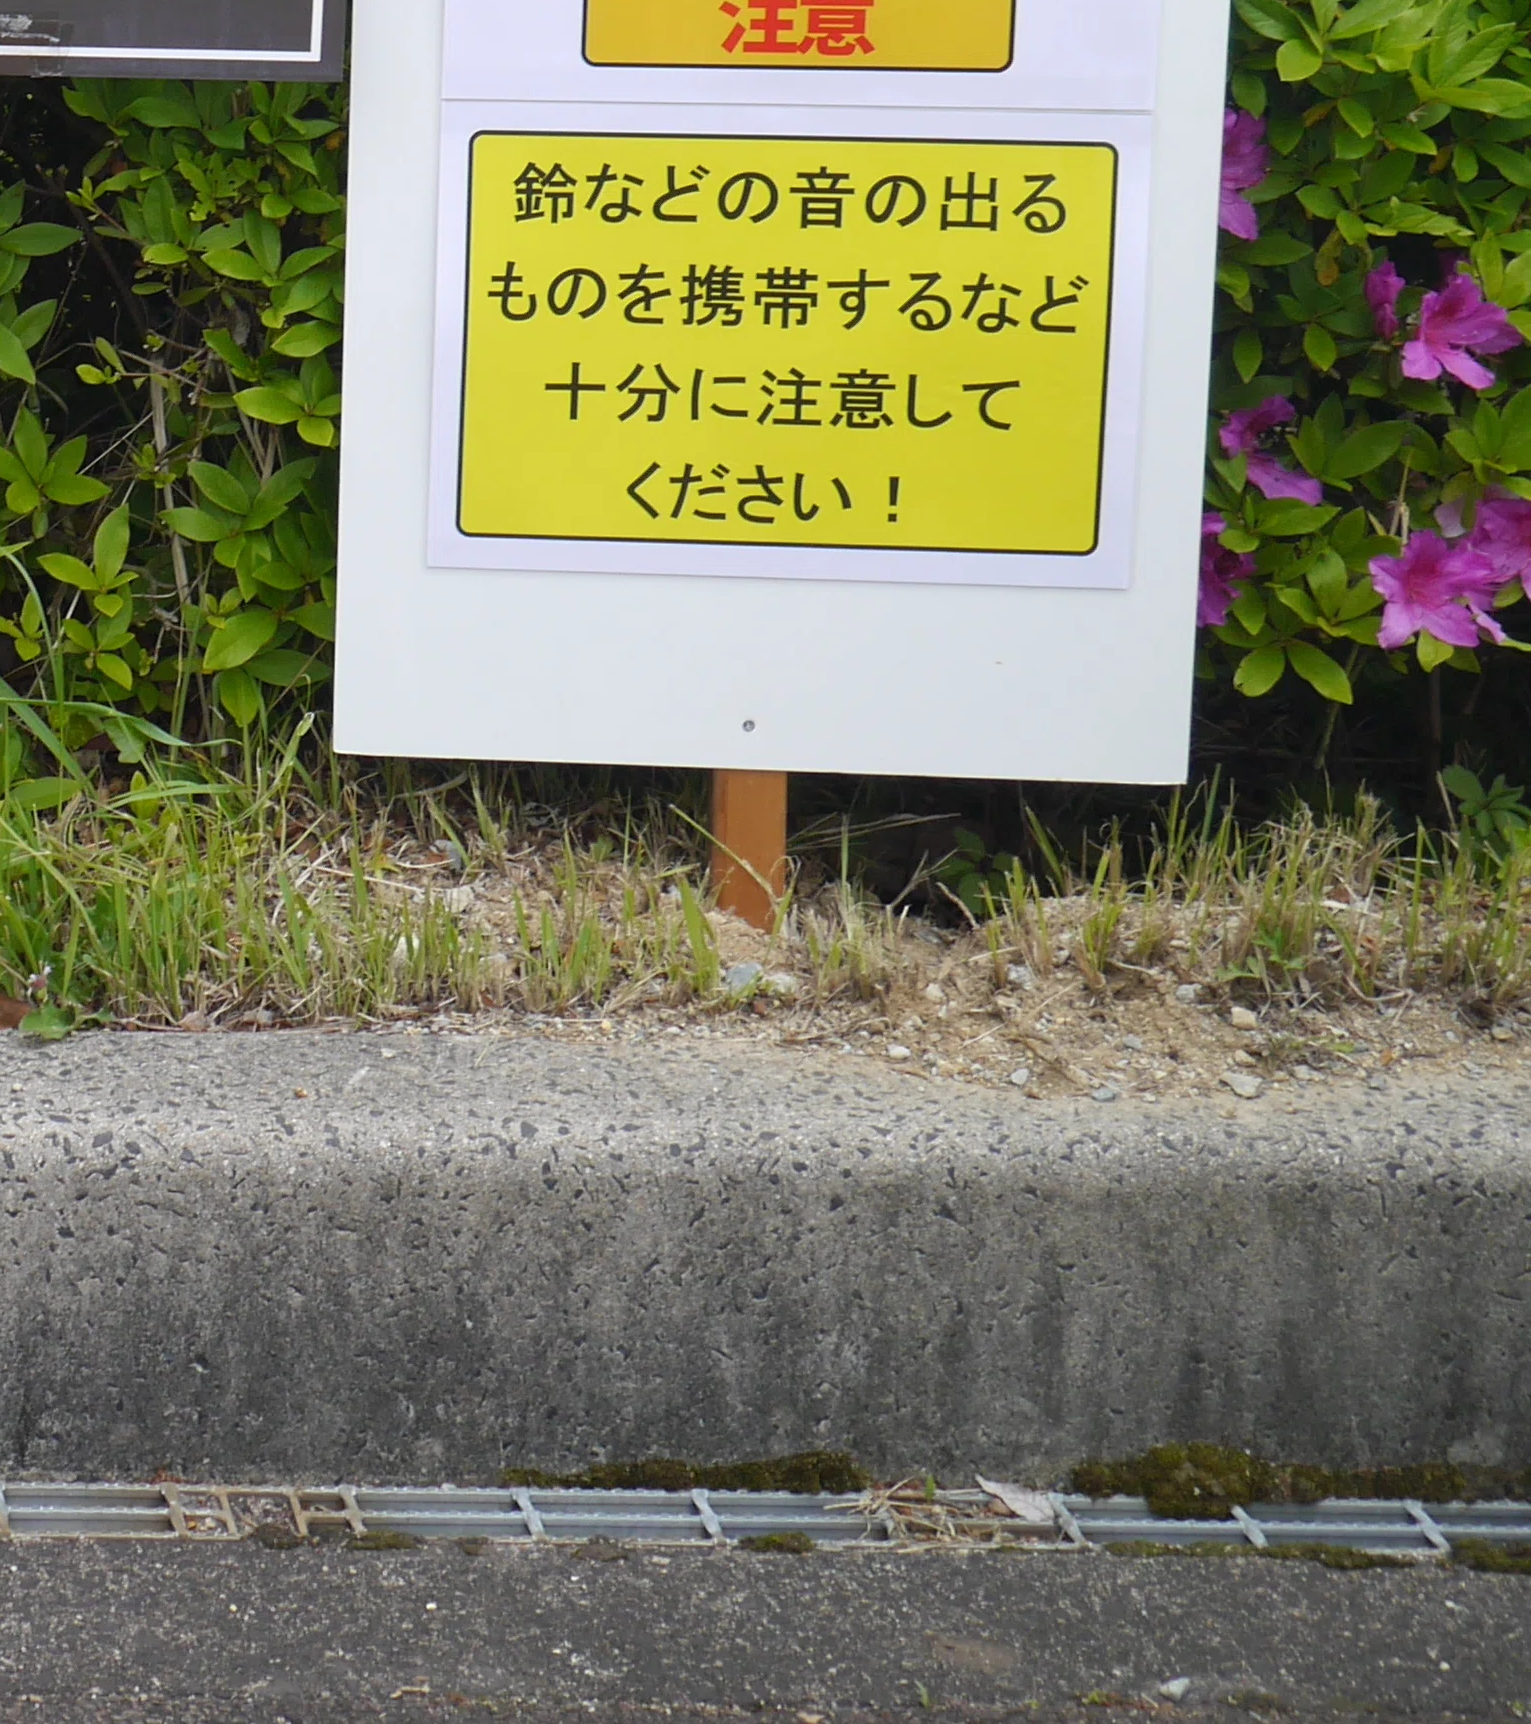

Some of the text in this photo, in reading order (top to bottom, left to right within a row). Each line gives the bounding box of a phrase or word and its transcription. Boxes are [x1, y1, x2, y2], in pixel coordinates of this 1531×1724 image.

[513, 161, 1069, 234] 鈴などの音の出る
[487, 261, 1090, 335] ものを携帯するなど
[544, 361, 1022, 431] 十分に注意して
